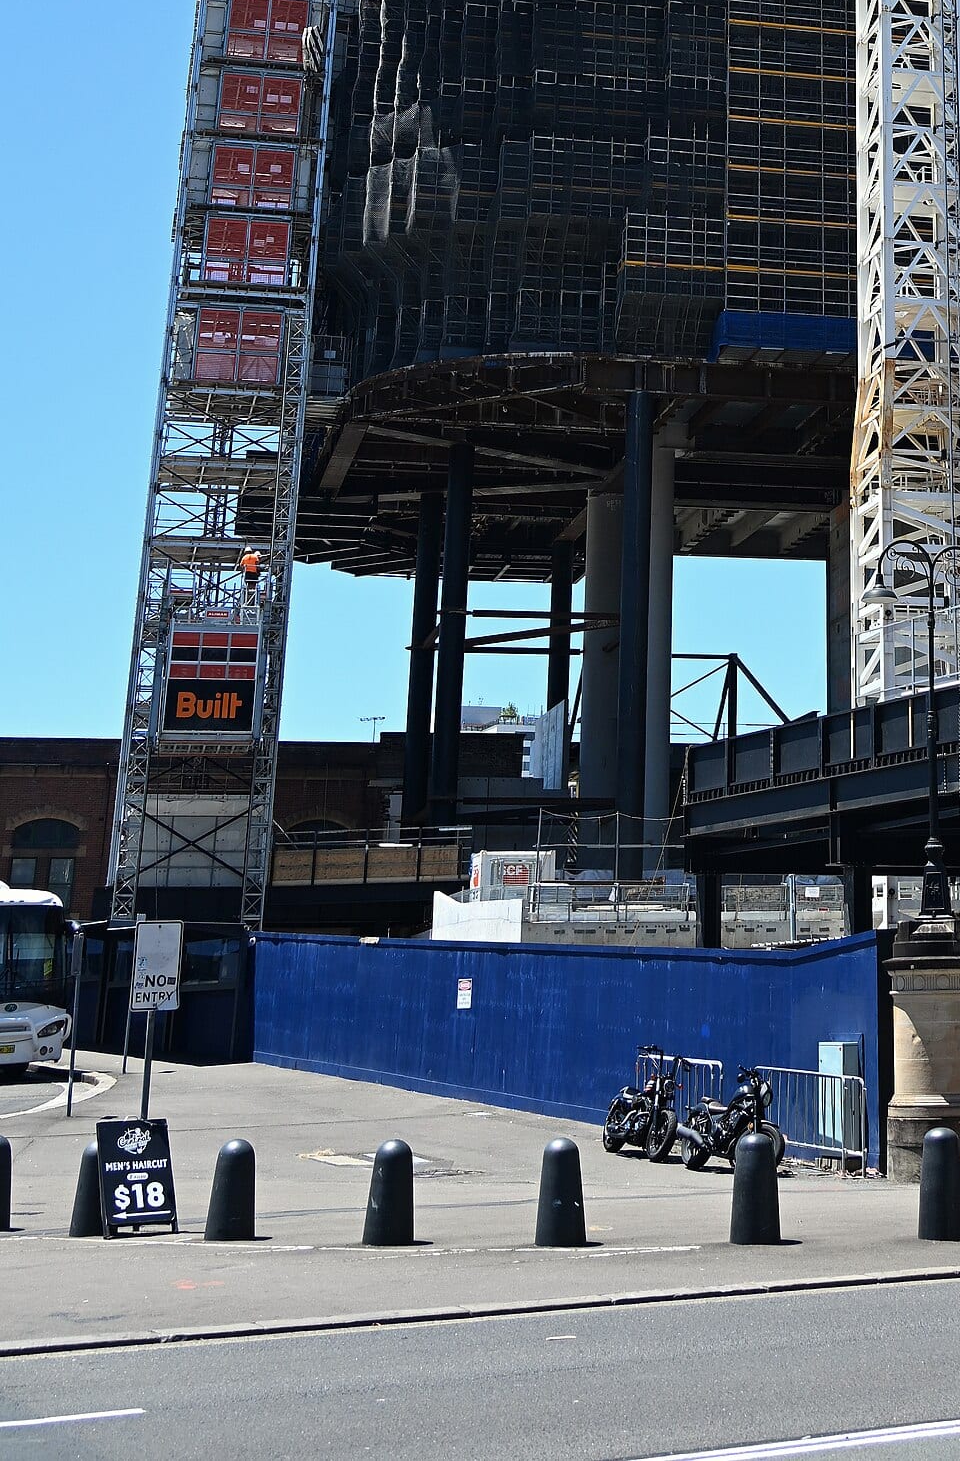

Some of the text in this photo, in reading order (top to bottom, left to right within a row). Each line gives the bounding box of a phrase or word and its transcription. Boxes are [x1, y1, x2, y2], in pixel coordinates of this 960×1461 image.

[176, 692, 243, 718] Built
[145, 975, 166, 987] NO
[136, 991, 174, 1003] ENTRY
[105, 1159, 168, 1172] MEN'S HAIRCUT
[114, 1181, 165, 1210] $18
